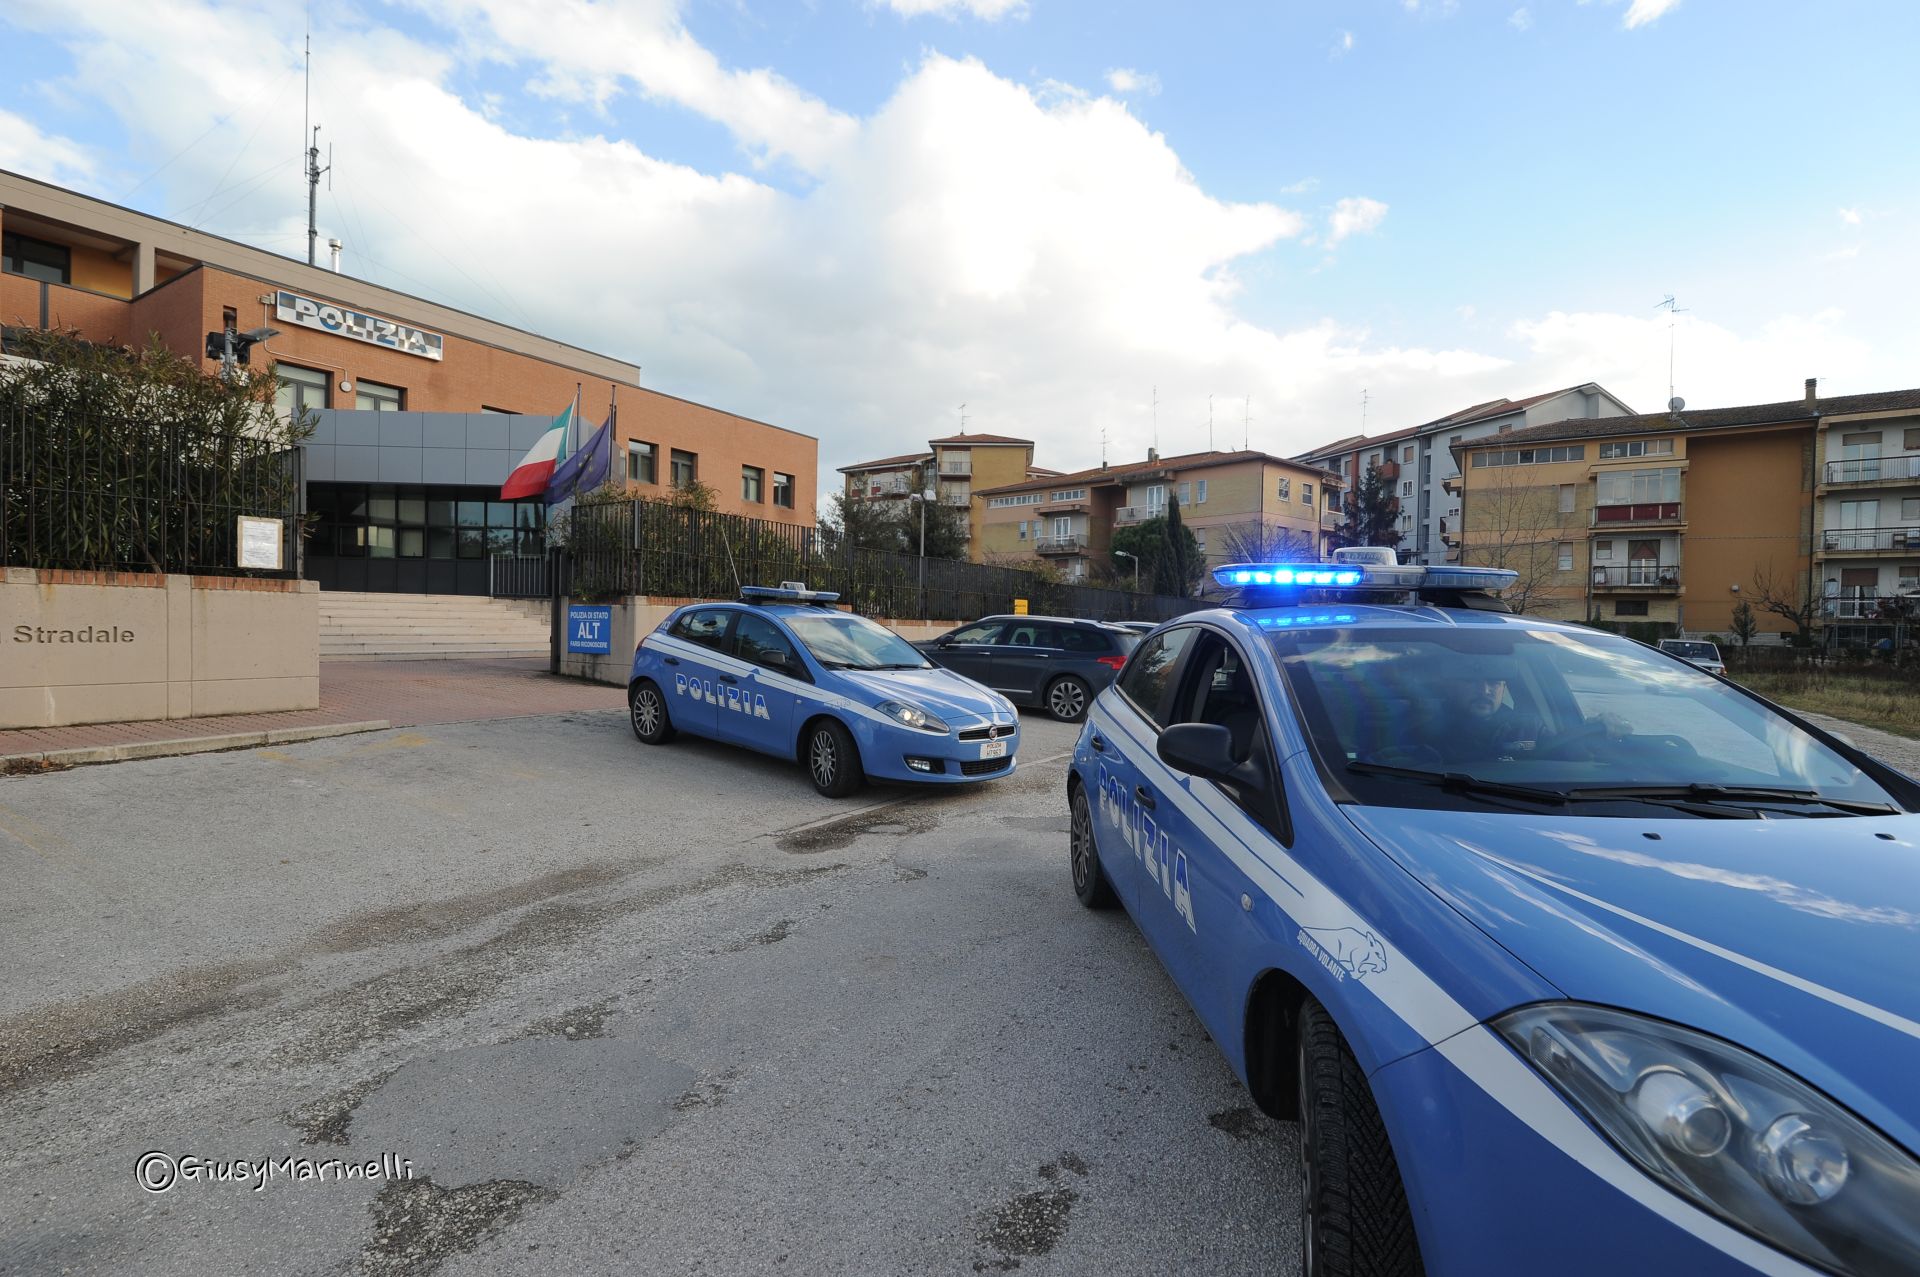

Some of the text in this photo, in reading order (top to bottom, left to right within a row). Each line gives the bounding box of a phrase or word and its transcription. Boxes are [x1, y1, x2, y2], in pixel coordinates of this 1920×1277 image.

[295, 297, 428, 353] POLIZIA
[13, 625, 135, 644] Stradale
[570, 611, 587, 619] POLIZIA
[577, 621, 600, 639] ALT
[675, 672, 770, 720] POLIZIA
[1099, 762, 1197, 935] POLIZIA
[1296, 930, 1346, 982] SQUADRA VOLANTE
